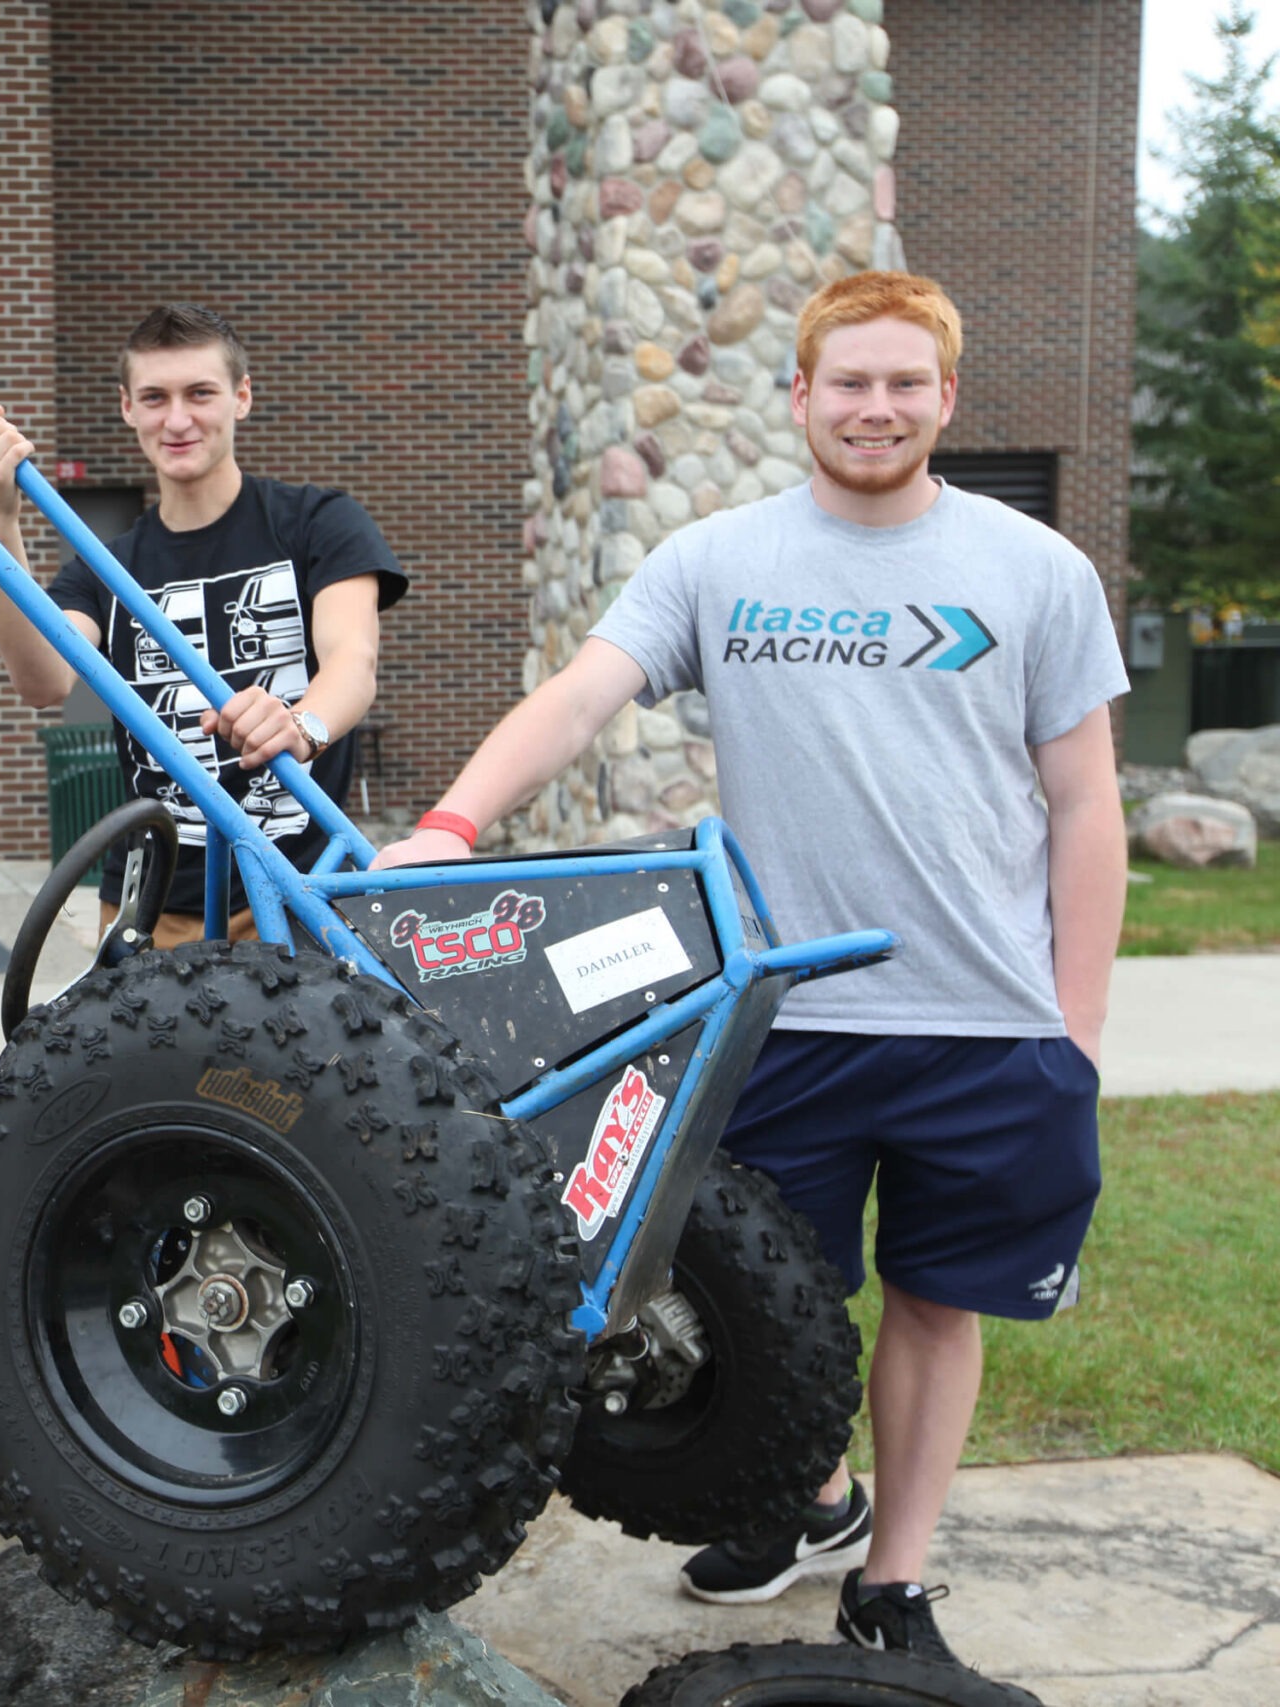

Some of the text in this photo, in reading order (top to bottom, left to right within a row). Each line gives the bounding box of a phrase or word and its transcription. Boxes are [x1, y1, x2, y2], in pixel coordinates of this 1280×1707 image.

[728, 597, 893, 637] Itasca
[722, 637, 889, 668] RACING
[412, 920, 522, 970] tsco
[428, 917, 483, 935] WEYHRICH
[421, 951, 526, 982] RACING
[576, 940, 656, 979] DAIMLER
[609, 1143, 631, 1187] SPOT
[633, 1094, 654, 1131] CYCLE
